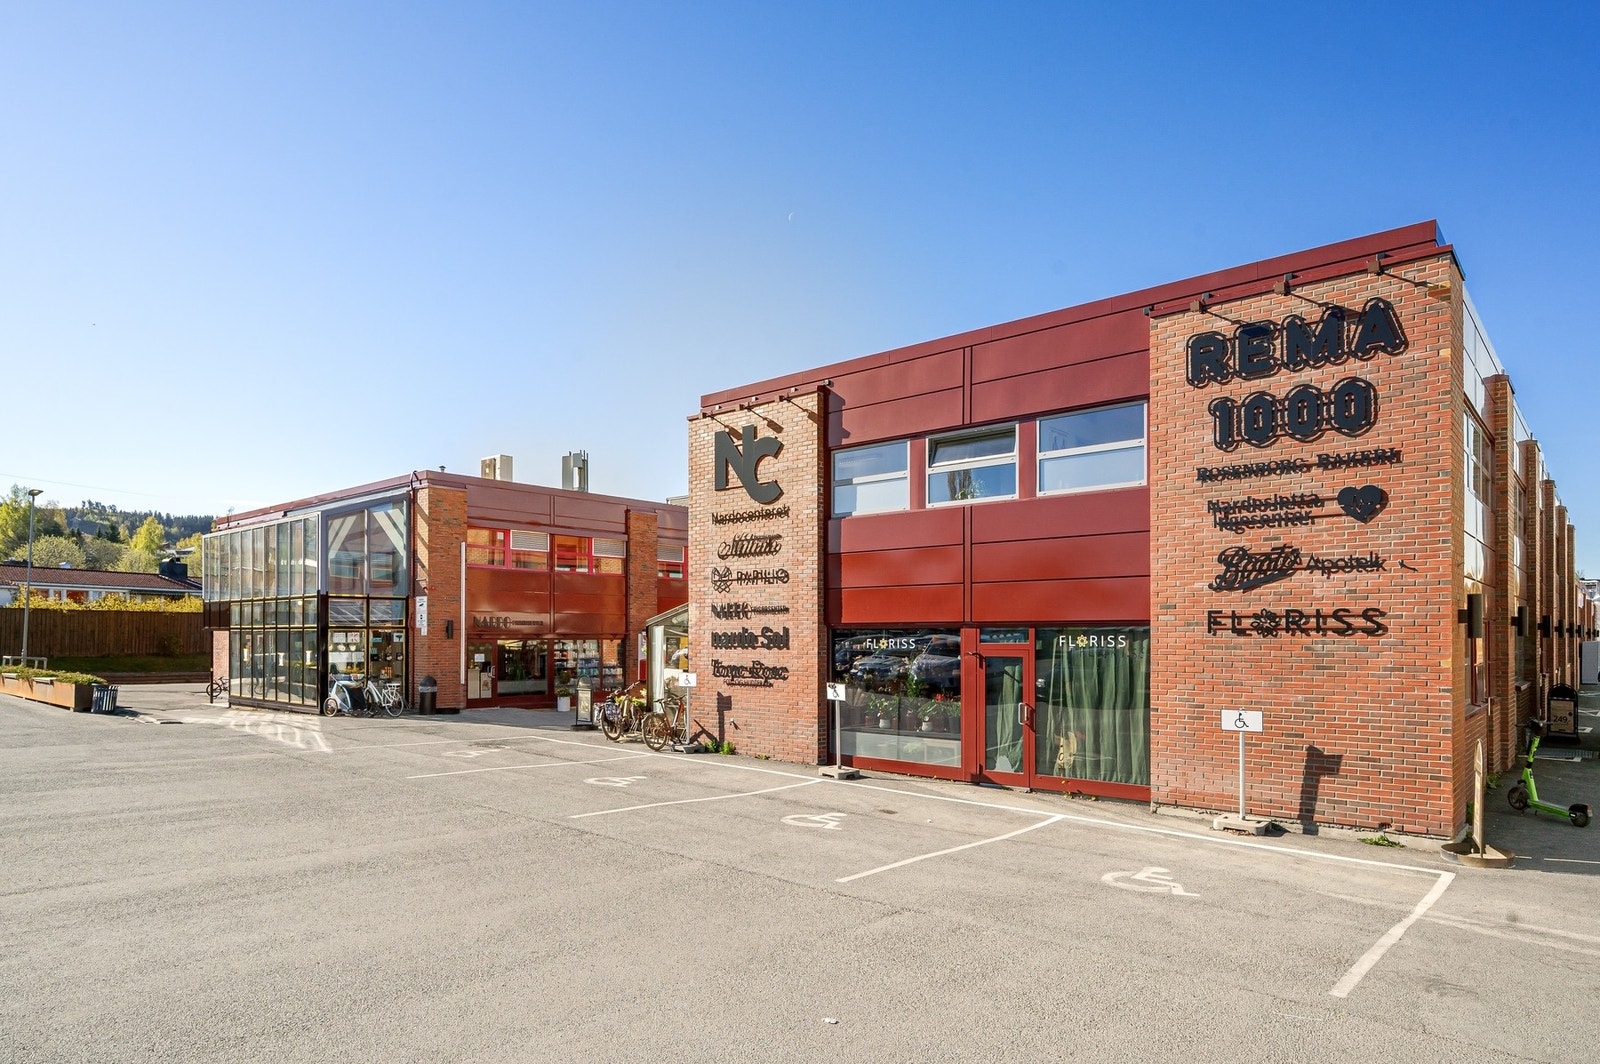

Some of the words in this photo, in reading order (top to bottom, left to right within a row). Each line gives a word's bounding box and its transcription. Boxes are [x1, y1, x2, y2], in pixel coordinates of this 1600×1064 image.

[1187, 297, 1408, 388] REMA
[1208, 376, 1378, 450] 1000
[1196, 458, 1311, 481] ROSENBORG
[1317, 448, 1401, 470] BAKERI
[1305, 551, 1387, 578] Apotek
[1059, 634, 1127, 649] FLORISS
